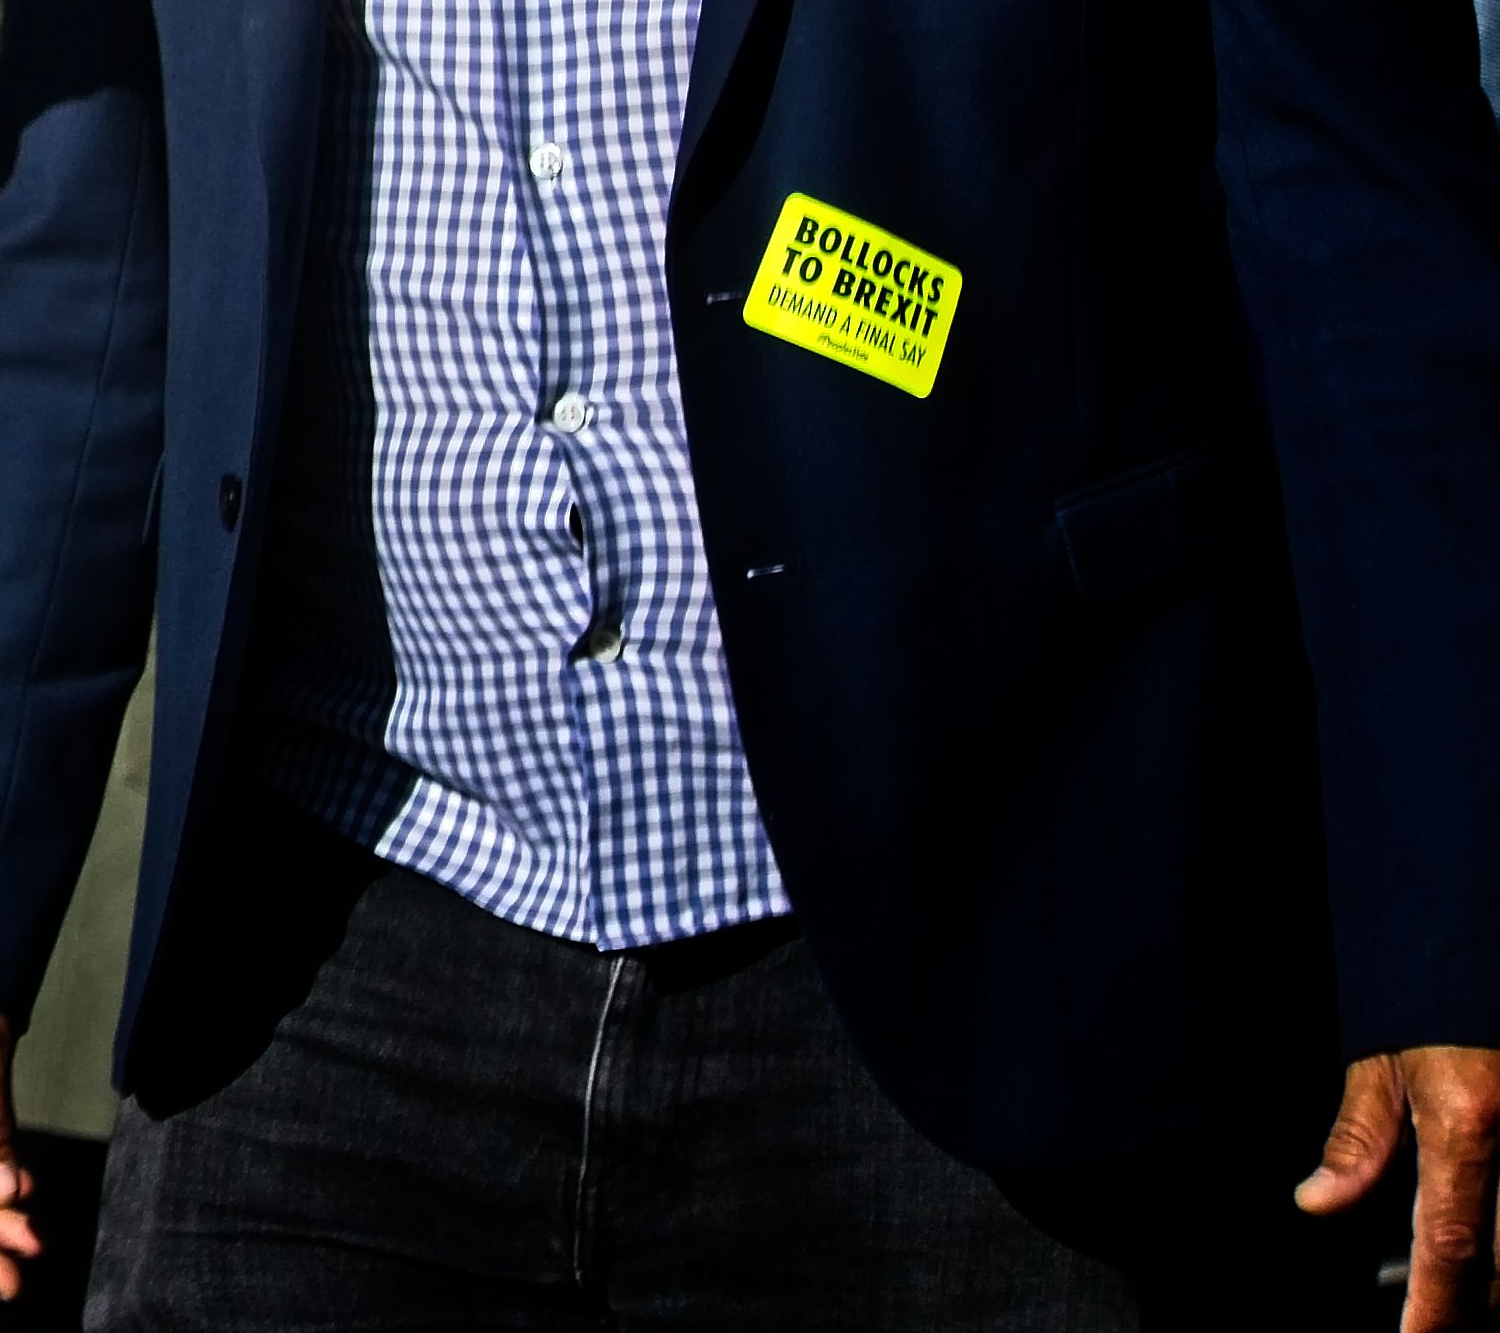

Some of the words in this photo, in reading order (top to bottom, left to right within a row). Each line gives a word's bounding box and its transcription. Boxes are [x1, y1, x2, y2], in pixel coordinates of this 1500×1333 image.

[781, 247, 823, 283] TO
[831, 269, 938, 338] BREXIT
[794, 216, 945, 309] BOLLOCKS
[767, 284, 838, 329] DEMAND
[839, 315, 851, 337] A
[855, 317, 896, 357] FINAL
[898, 338, 927, 369] SAY
